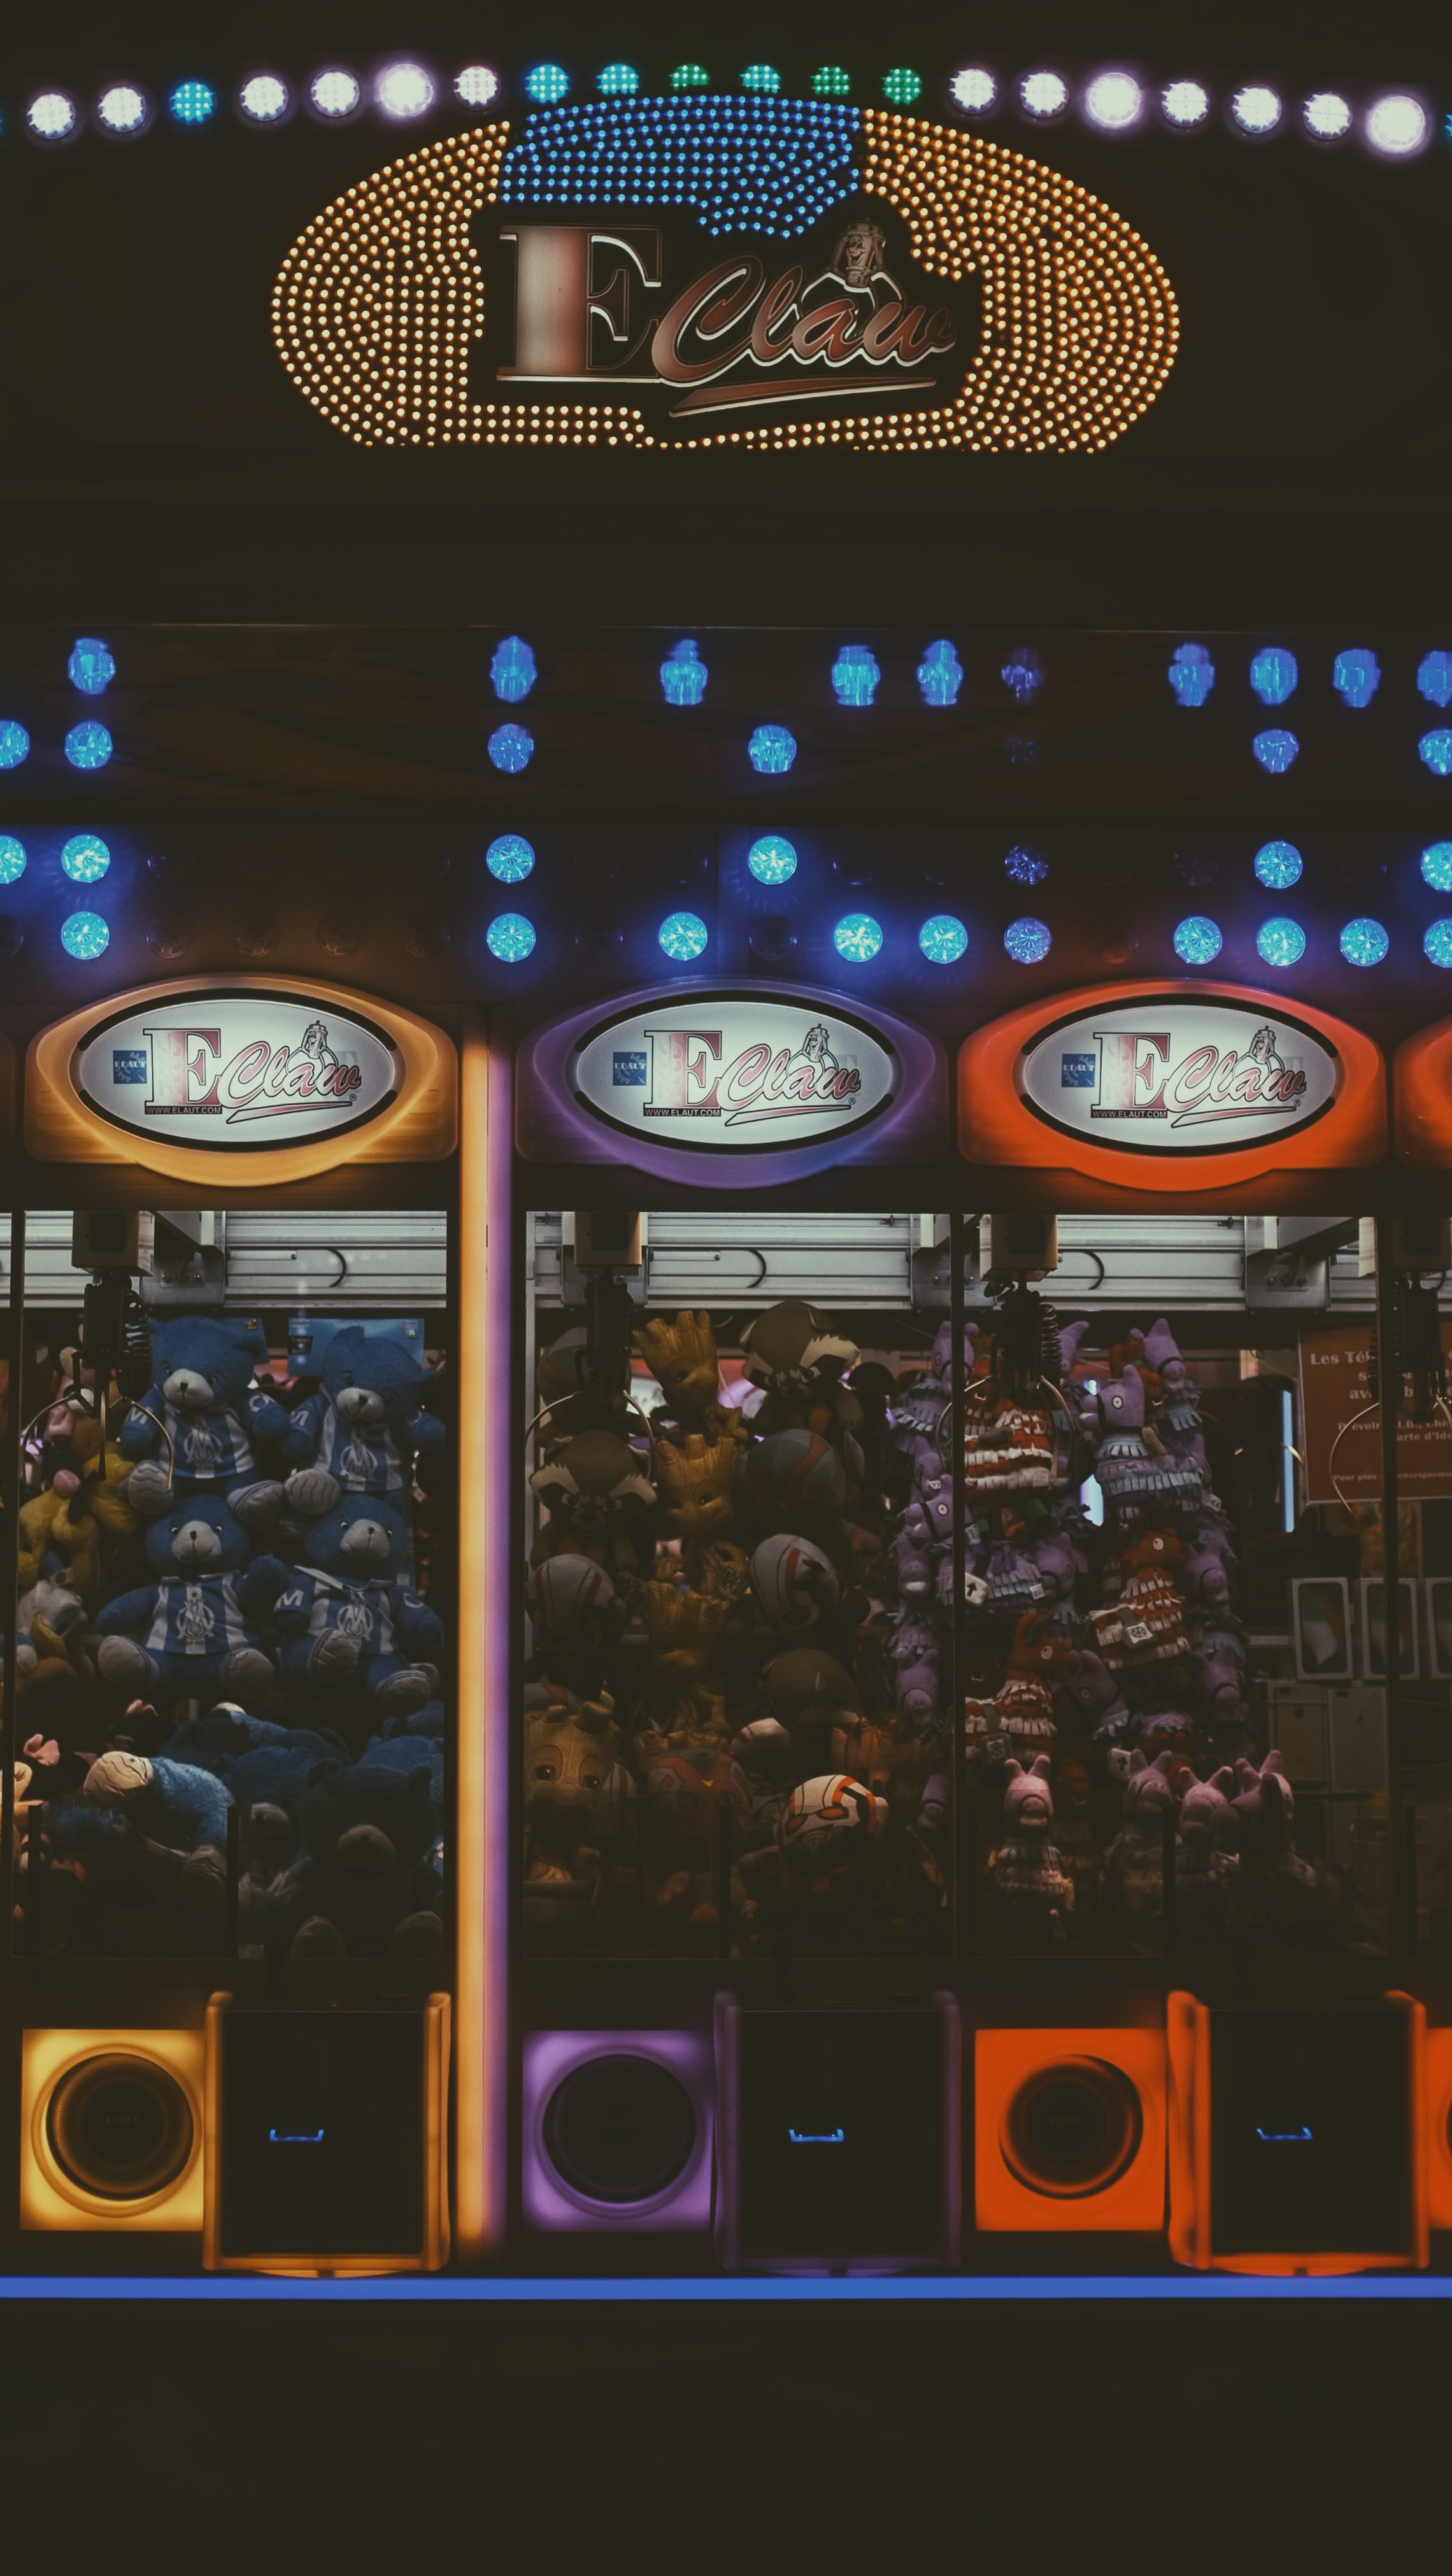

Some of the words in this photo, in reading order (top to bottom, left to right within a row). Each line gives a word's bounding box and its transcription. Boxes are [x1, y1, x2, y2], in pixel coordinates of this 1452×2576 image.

[1092, 1110, 1167, 1119] WWW.ELAUT.COM
[1310, 1352, 1340, 1366] Les
[1337, 1420, 1381, 1431] Pévoir
[1396, 1432, 1421, 1441] arte
